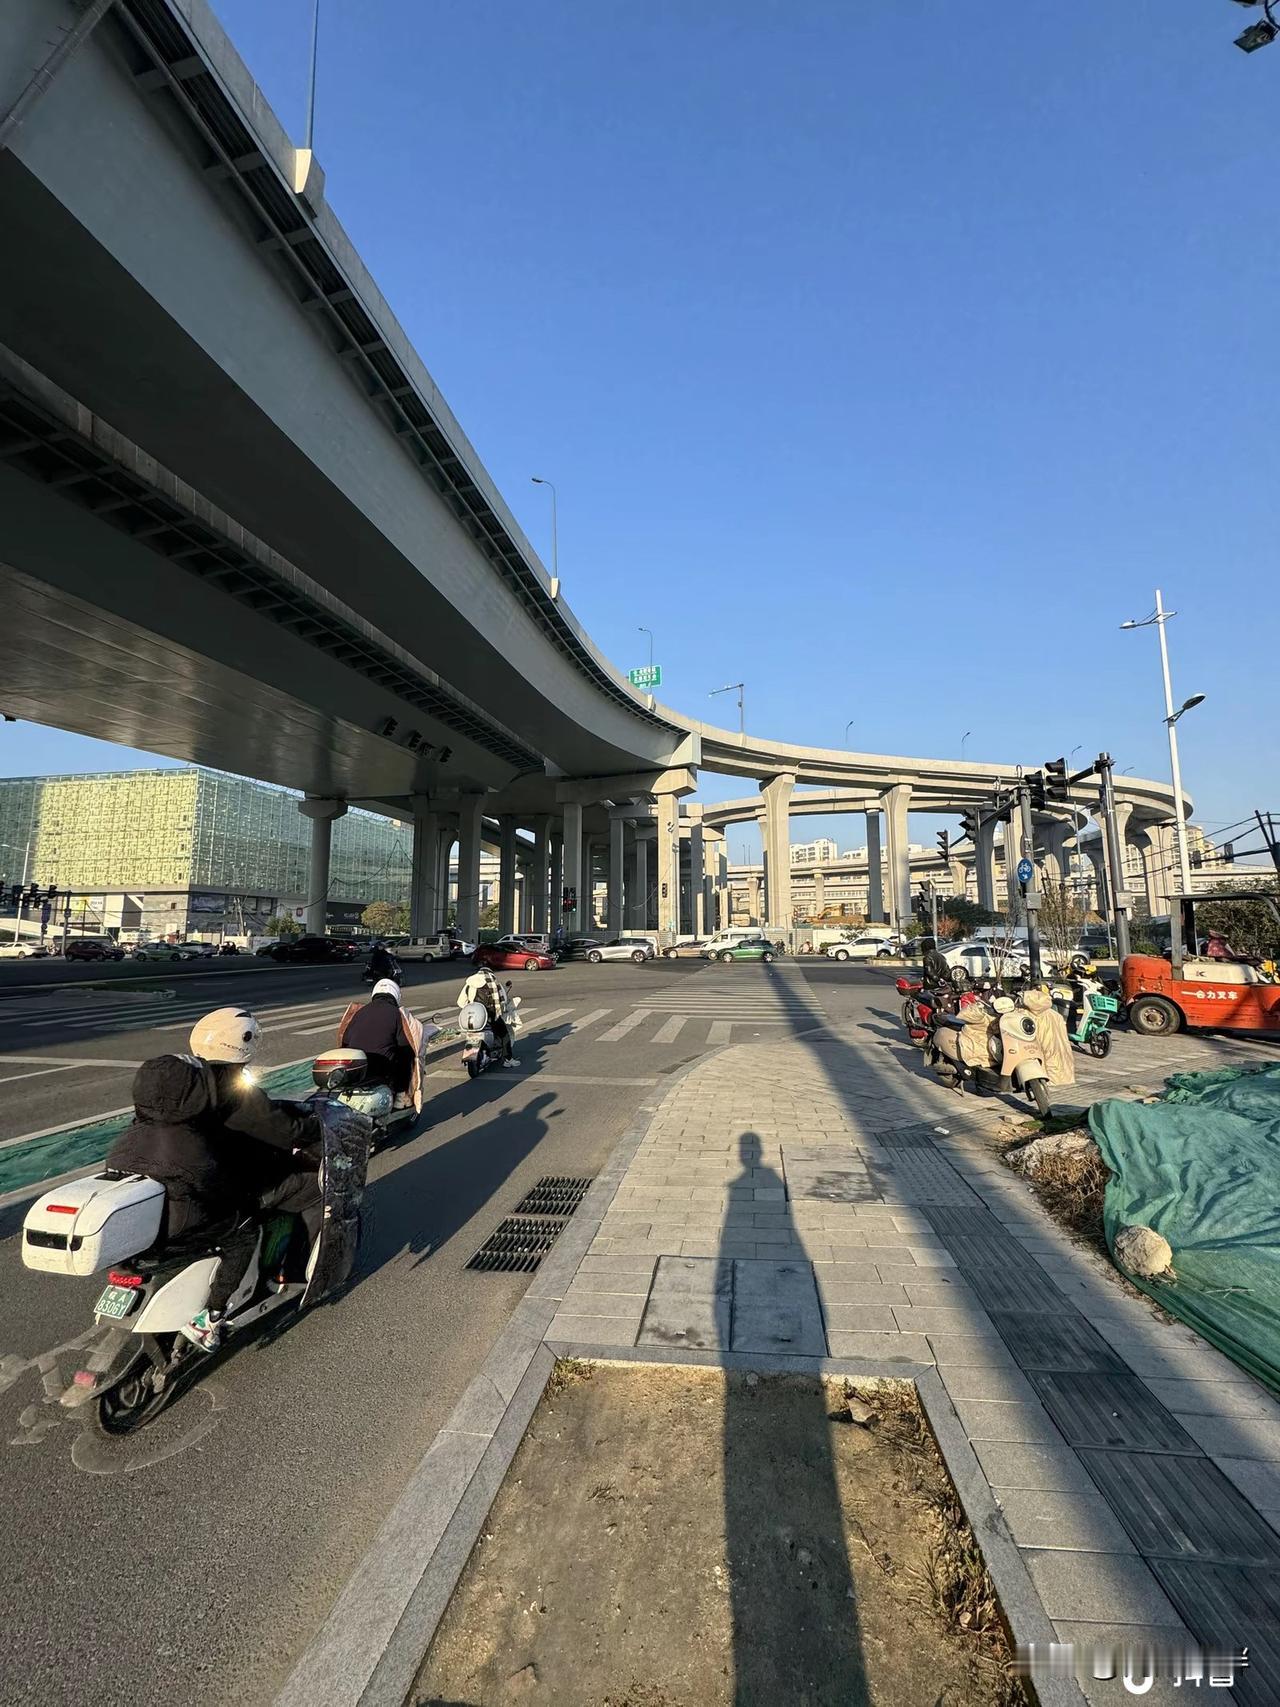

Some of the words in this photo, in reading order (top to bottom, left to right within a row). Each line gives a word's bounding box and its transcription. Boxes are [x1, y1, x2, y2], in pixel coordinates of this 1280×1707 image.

[1196, 990, 1238, 1000] 合力叉车
[97, 1299, 126, 1316] 8306Y
